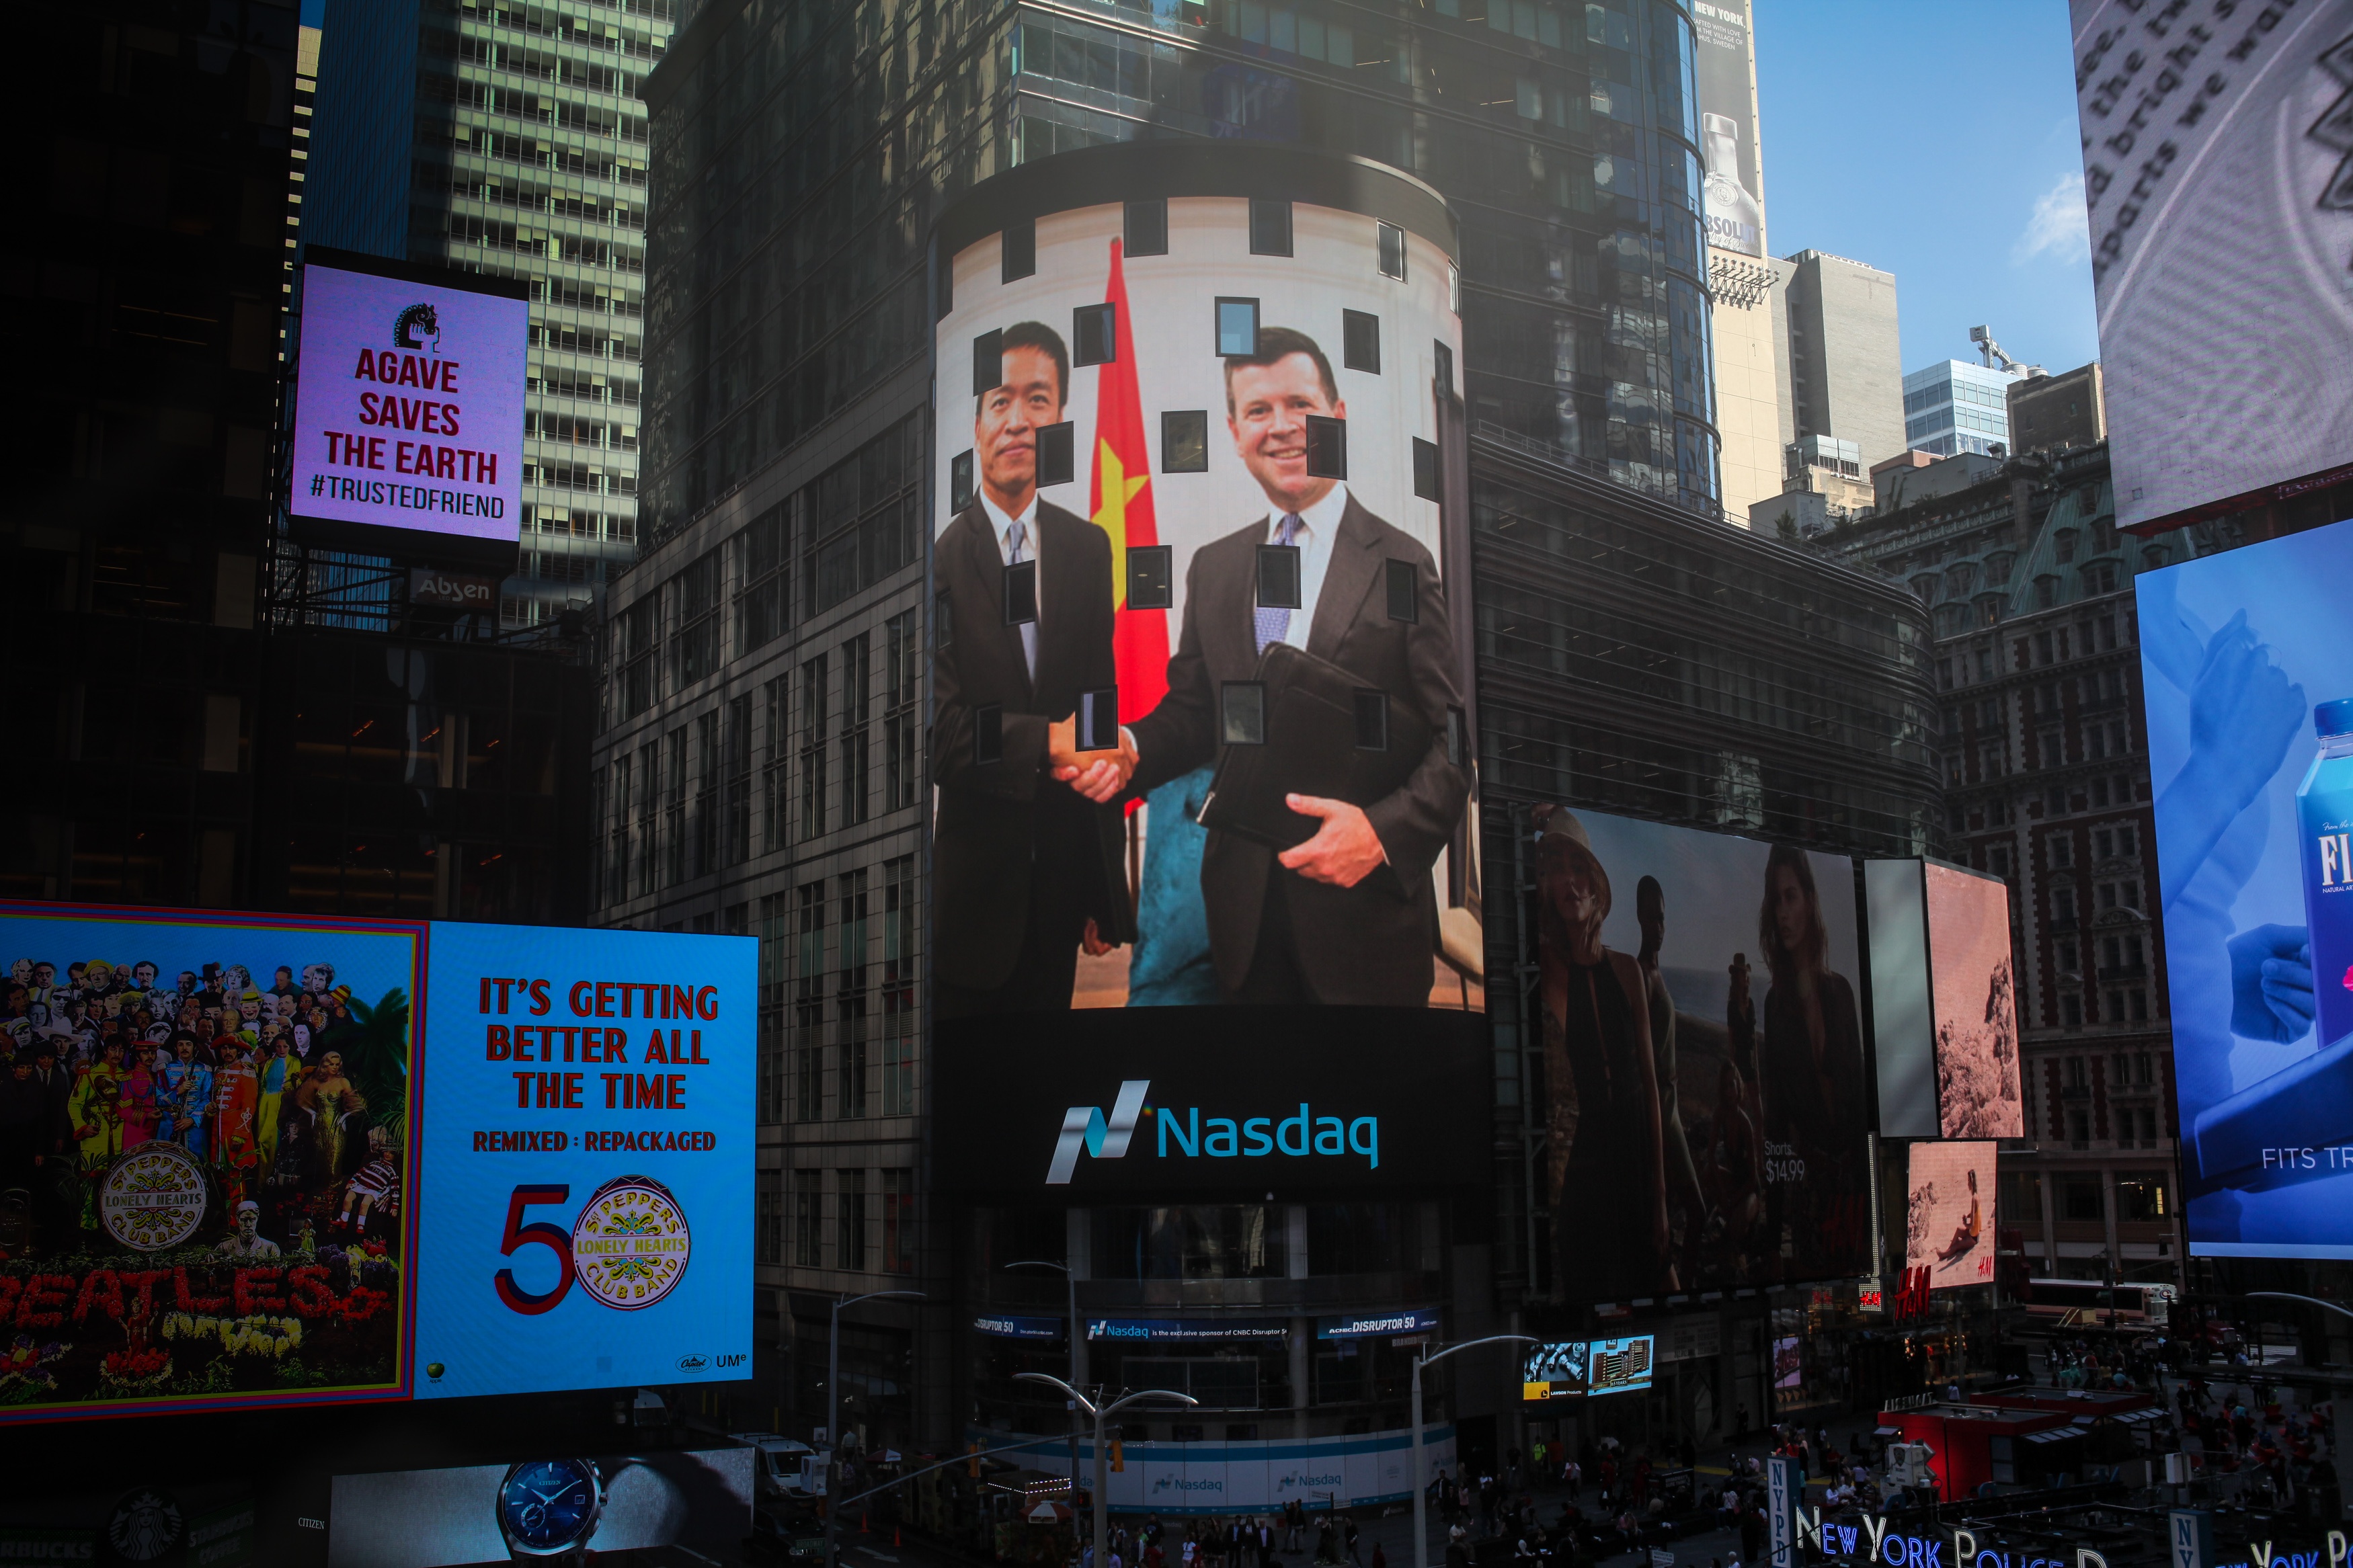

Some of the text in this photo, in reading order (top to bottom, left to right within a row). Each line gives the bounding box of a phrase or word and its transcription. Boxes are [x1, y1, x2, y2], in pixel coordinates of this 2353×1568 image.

[1695, 1, 1746, 28] NEW YORK,
[1694, 18, 1711, 28] AFTED
[1712, 24, 1726, 33] WITH
[1727, 29, 1741, 38] LOVE
[1703, 28, 1712, 36] THE
[1714, 32, 1734, 43] VILLAGE
[1713, 38, 1735, 50] SWEDEN
[2176, 71, 2227, 128] we
[2224, 0, 2298, 63] wa
[2089, 49, 2146, 120] the
[2103, 22, 2213, 160] bright
[1706, 214, 1755, 243] BSOLUT
[355, 348, 459, 393] AGAVE
[359, 392, 461, 436] SAVES
[324, 431, 497, 485] THE EARTH
[311, 474, 504, 520] #TRUSTEDFRIEND
[419, 577, 489, 602] Absen
[2322, 821, 2338, 831] From
[2339, 819, 2349, 829] the
[479, 977, 718, 1020] IT'S GETTING
[486, 1025, 710, 1065] BETTER ALL
[513, 1072, 686, 1109] THE TIME
[473, 1131, 567, 1152] REMIXED
[585, 1132, 716, 1151] REPACKAGED
[1158, 1102, 1378, 1170] Nasdaq
[1765, 1141, 1792, 1155] Shorts
[372, 1167, 383, 1175] THE
[1766, 1158, 1805, 1184] $14.99
[2262, 1147, 2316, 1169] FITS
[125, 1155, 198, 1190] PEPPERS
[106, 1193, 202, 1207] LONELY HEARTS
[600, 1192, 680, 1234] PEPPERS
[112, 1211, 195, 1243] CLUB BAND
[577, 1238, 686, 1254] LONELY HEARTS
[586, 1259, 678, 1299] CLUB BAND
[978, 1318, 1002, 1331] DISRUPTOR
[1004, 1321, 1013, 1333] 50
[1107, 1326, 1149, 1339] Nasdaq
[1353, 1317, 1403, 1333] DISRUPTOR
[1404, 1316, 1414, 1329] 50
[1392, 1336, 1417, 1347] BRANDED
[1175, 1479, 1222, 1492] Nasdaq
[1299, 1474, 1341, 1486] Nasdaq
[298, 1517, 325, 1530] CITIZEN
[1772, 1462, 1786, 1563] NYPD
[1796, 1505, 1858, 1555] NEW
[797, 1538, 824, 1549] BROADWAY
